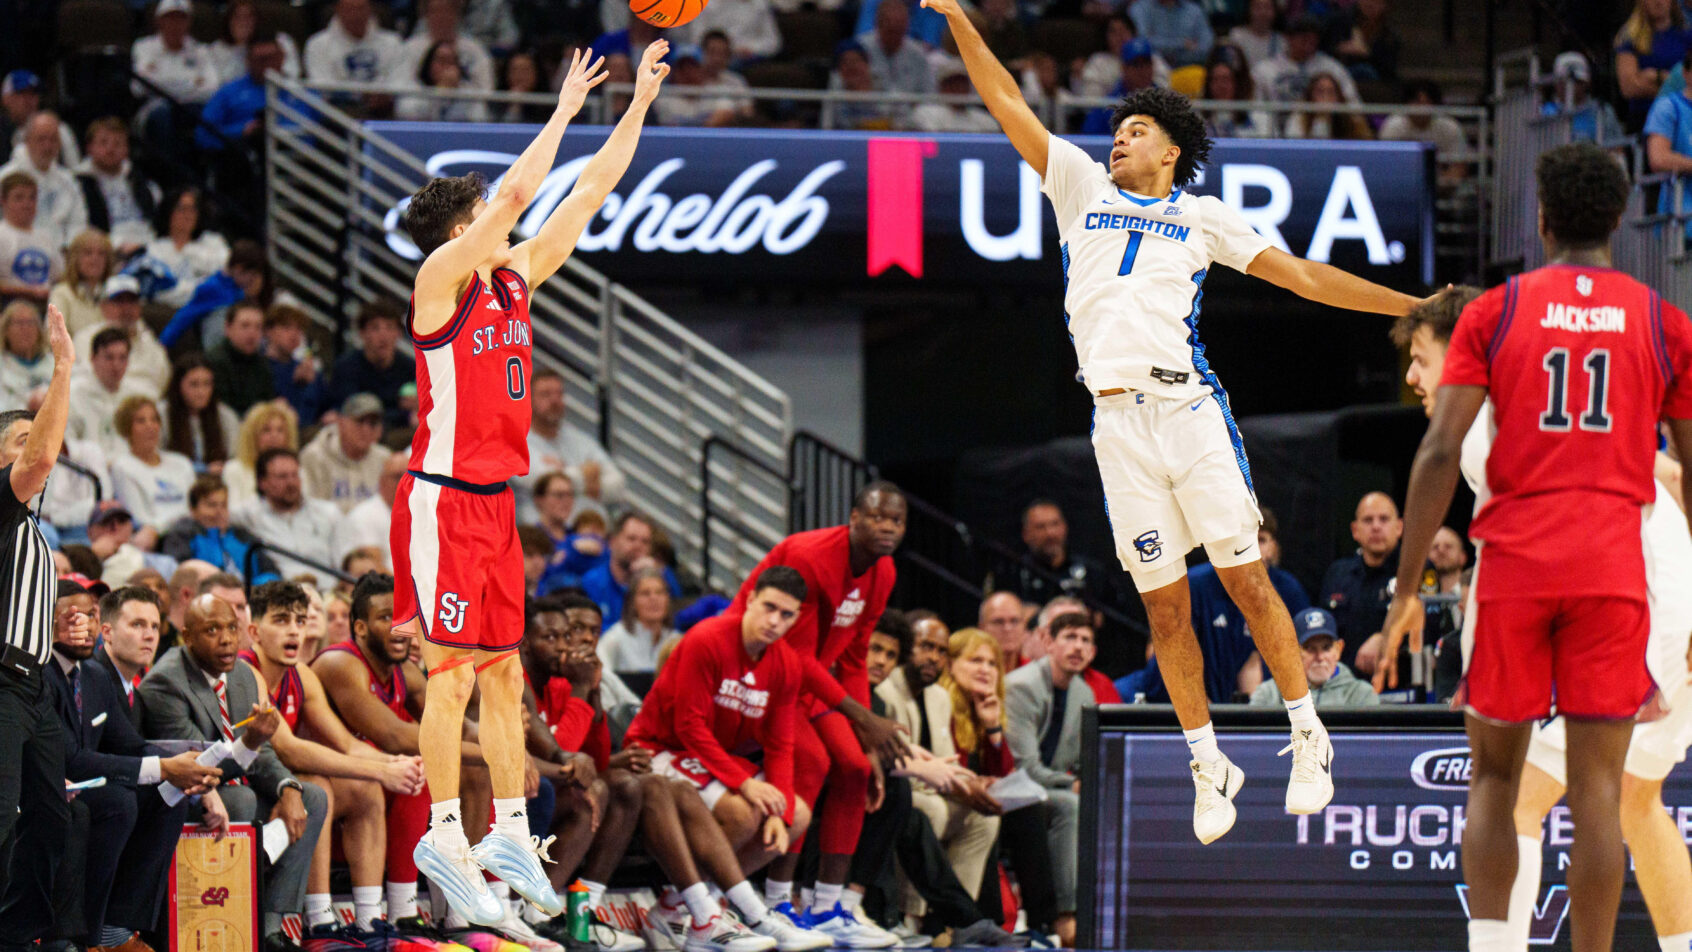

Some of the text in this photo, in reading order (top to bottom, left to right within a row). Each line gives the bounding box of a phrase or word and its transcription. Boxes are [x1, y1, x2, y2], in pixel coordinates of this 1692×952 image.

[1085, 212, 1191, 243] CREIGHTON
[1117, 230, 1144, 277] 1
[1540, 302, 1626, 334] JACKSON
[506, 356, 526, 400] 0
[1539, 347, 1613, 434] 11
